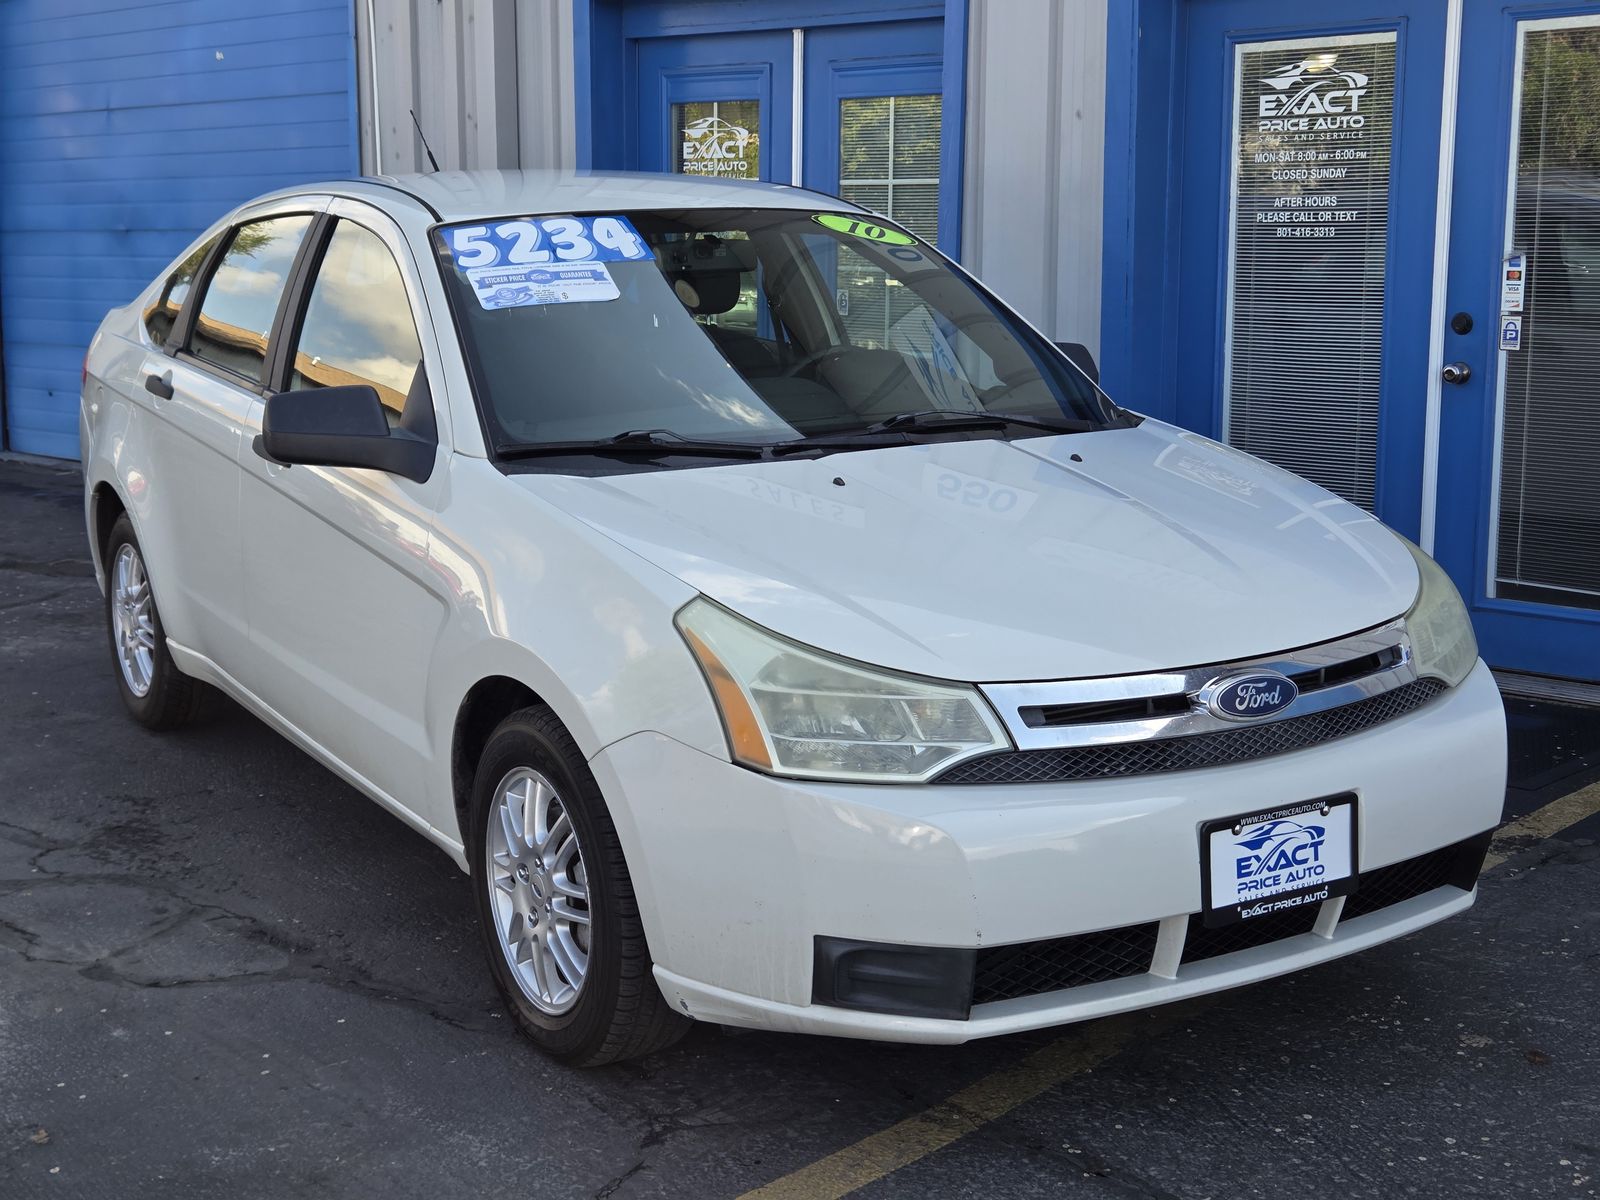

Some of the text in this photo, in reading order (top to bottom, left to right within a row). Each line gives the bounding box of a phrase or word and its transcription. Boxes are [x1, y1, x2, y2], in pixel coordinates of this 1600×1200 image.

[1259, 82, 1367, 117] EXACT
[1258, 115, 1365, 132] PRICE AUTO
[1258, 131, 1364, 142] SALES AND SERVICE
[683, 134, 748, 159] EXACT
[1254, 150, 1296, 163] MON-SAT
[1297, 151, 1317, 162] 8:00
[1318, 152, 1329, 160] AM
[1335, 149, 1355, 160] 6:00
[1356, 151, 1367, 159] PM
[683, 160, 748, 171] PRICE AUTO
[1271, 168, 1347, 180] CLOSED SUNDAY
[1273, 196, 1337, 208] AFTER HOURS
[1256, 210, 1358, 222] PLEASE CALL OR TEXT
[847, 221, 886, 239] 10
[1276, 226, 1335, 238] 801-416-3313
[452, 217, 646, 268] 5234
[484, 276, 508, 284] STICKER
[509, 274, 526, 283] PRICE
[559, 271, 593, 279] GUARANTEE
[1235, 681, 1282, 711] Ford
[1240, 801, 1326, 826] WWW.EXACTPRICEAUTO.COM
[1236, 837, 1325, 879] EXACT
[1237, 864, 1325, 894] PRICE AUTO
[1241, 890, 1328, 918] EXACT PRICE AUTO
